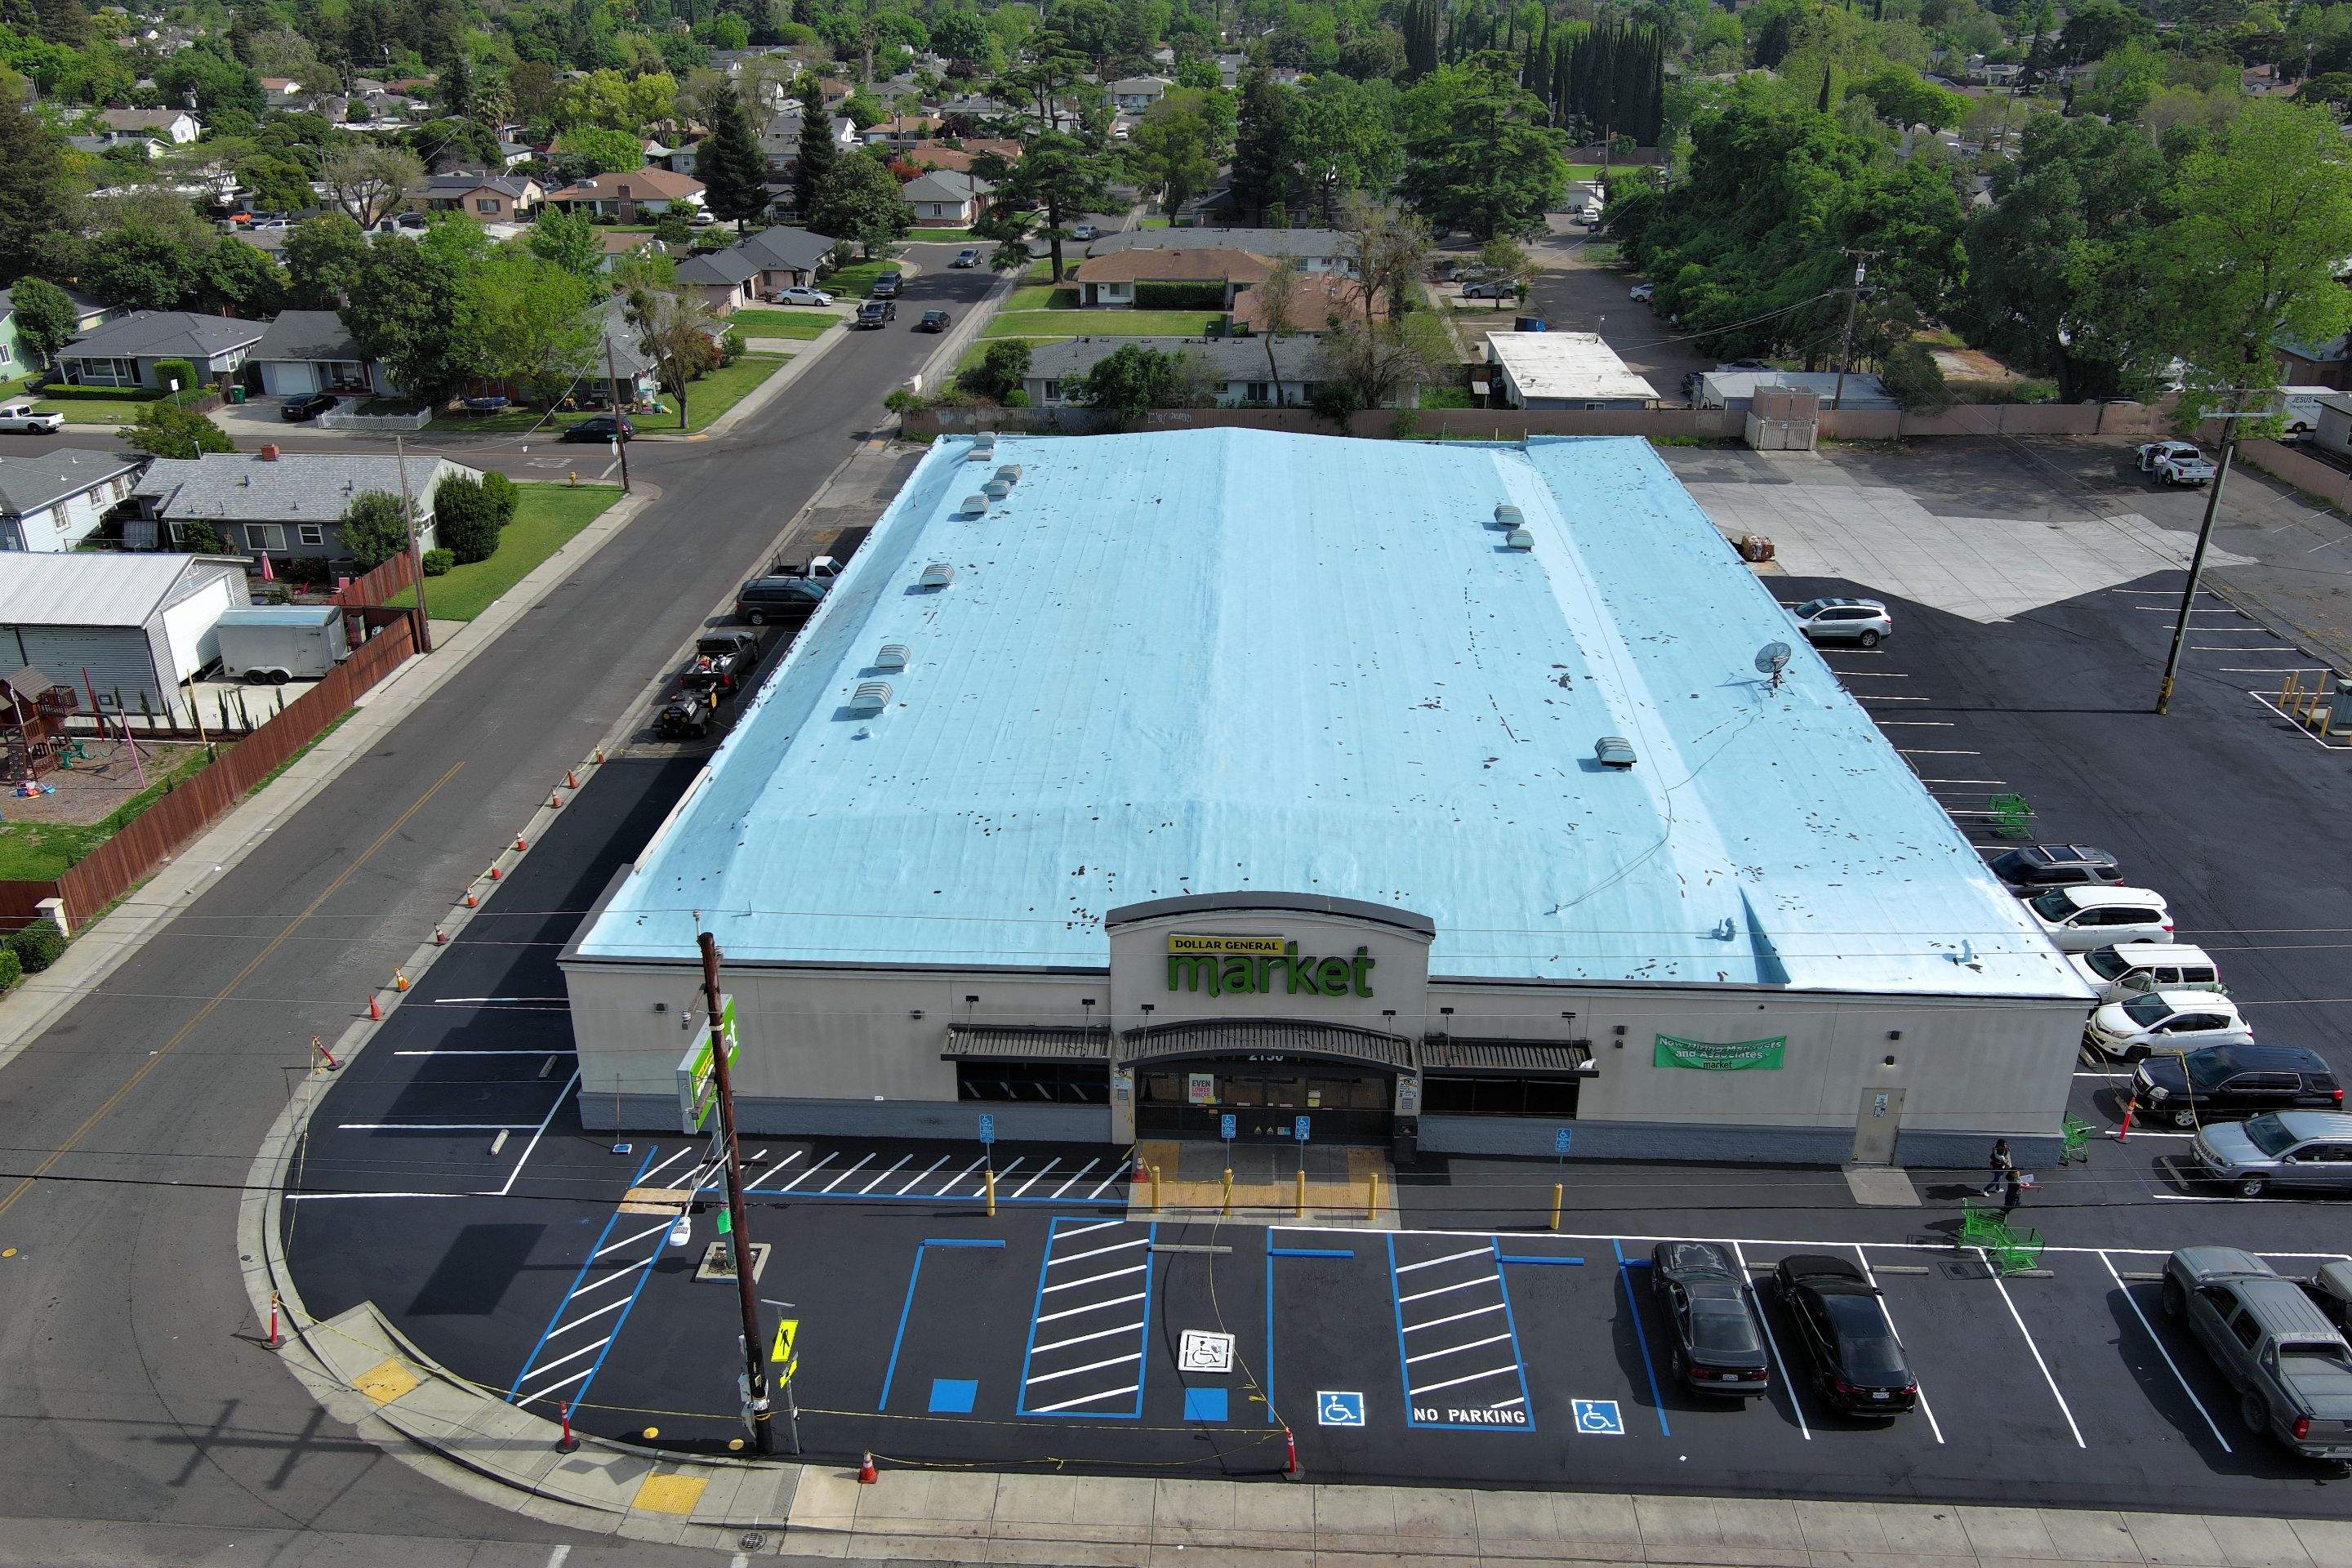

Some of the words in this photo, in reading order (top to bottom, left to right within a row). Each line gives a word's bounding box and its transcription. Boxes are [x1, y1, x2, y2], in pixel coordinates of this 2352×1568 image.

[1175, 940, 1222, 950] DOLLAR
[1225, 941, 1279, 951] GENERAL
[1168, 941, 1375, 999] market
[1659, 1037, 1682, 1047] Now
[1703, 1061, 1732, 1069] market
[1414, 1407, 1438, 1421] NO
[1448, 1409, 1526, 1423] PARKING
